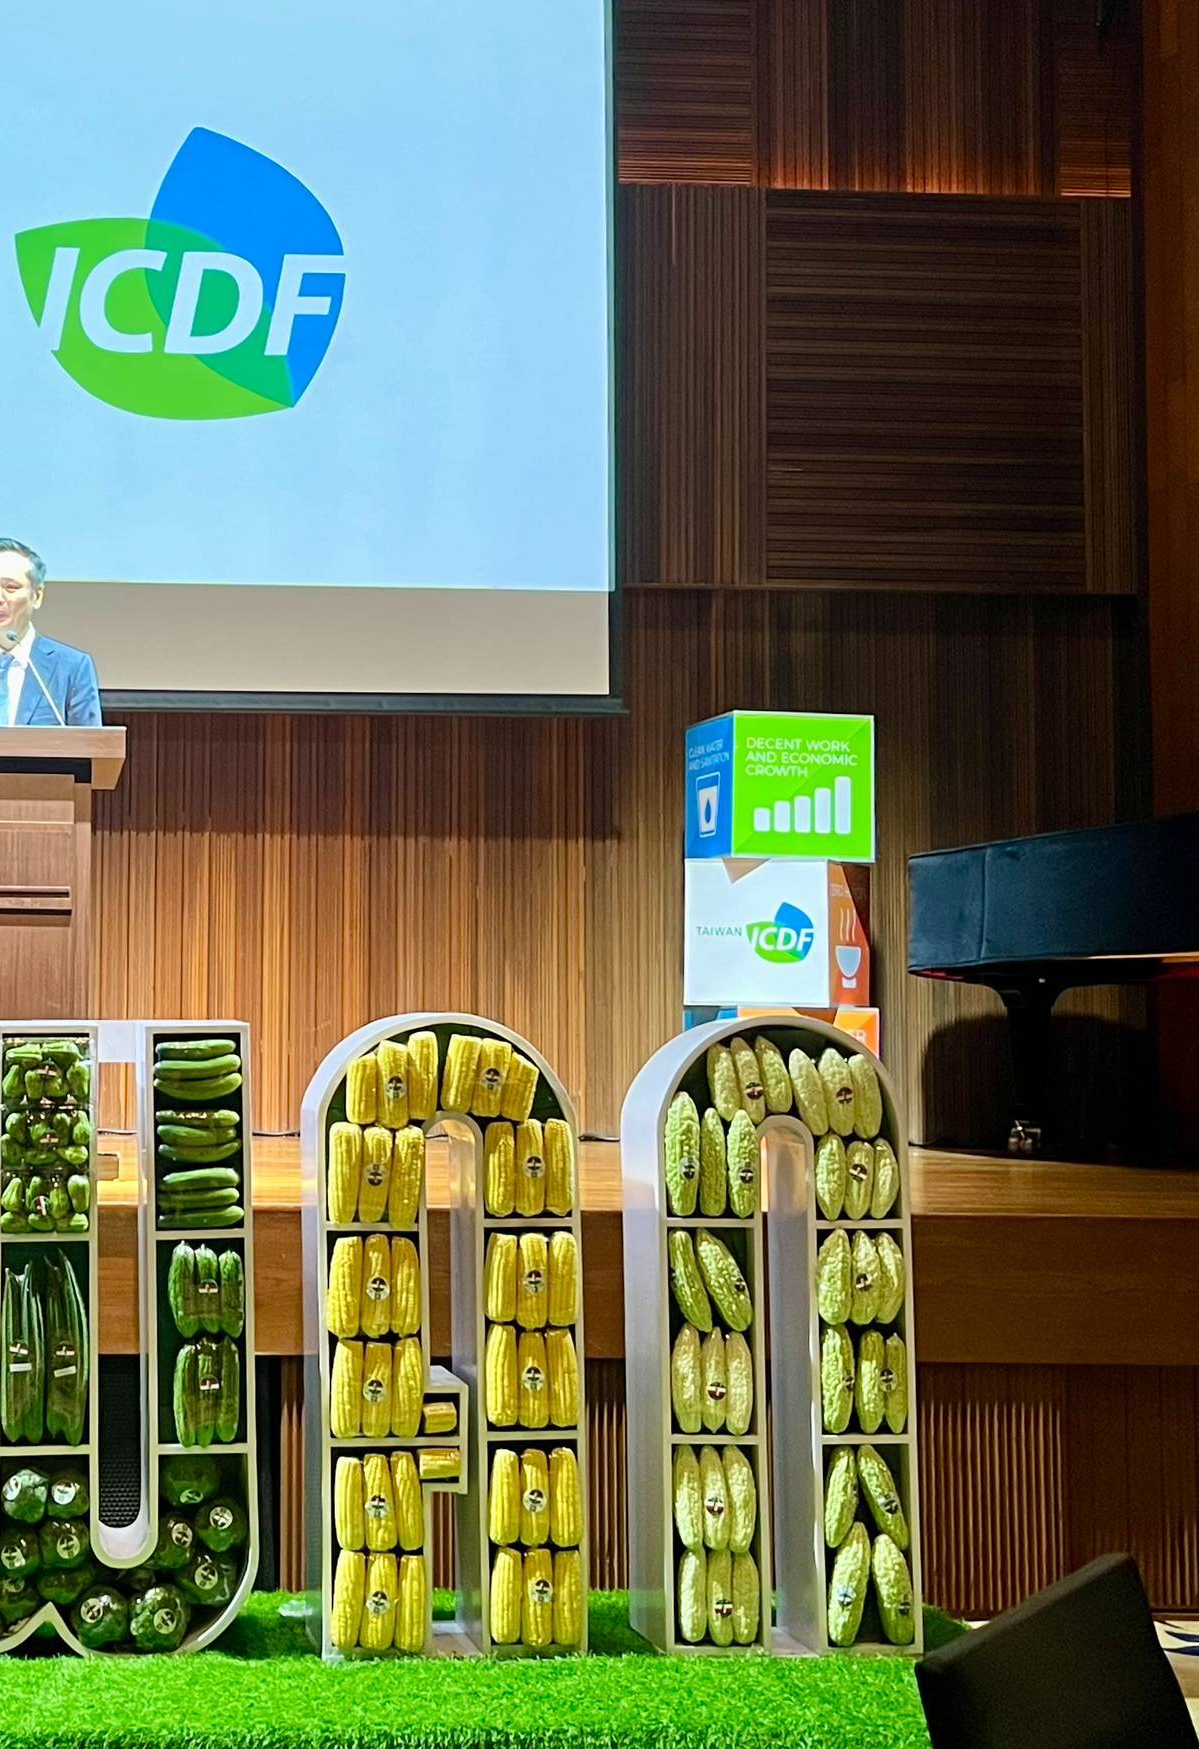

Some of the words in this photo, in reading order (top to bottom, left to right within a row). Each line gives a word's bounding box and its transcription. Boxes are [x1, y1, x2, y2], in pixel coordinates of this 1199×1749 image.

[38, 246, 346, 357] ICDF
[746, 737, 802, 750] DECENT
[805, 739, 851, 753] WORK
[746, 752, 777, 763] AND
[781, 753, 858, 766] ECONOMIC
[746, 765, 808, 778] GROWTH
[696, 926, 743, 937] TAIWAN
[750, 927, 814, 951] ICDF
